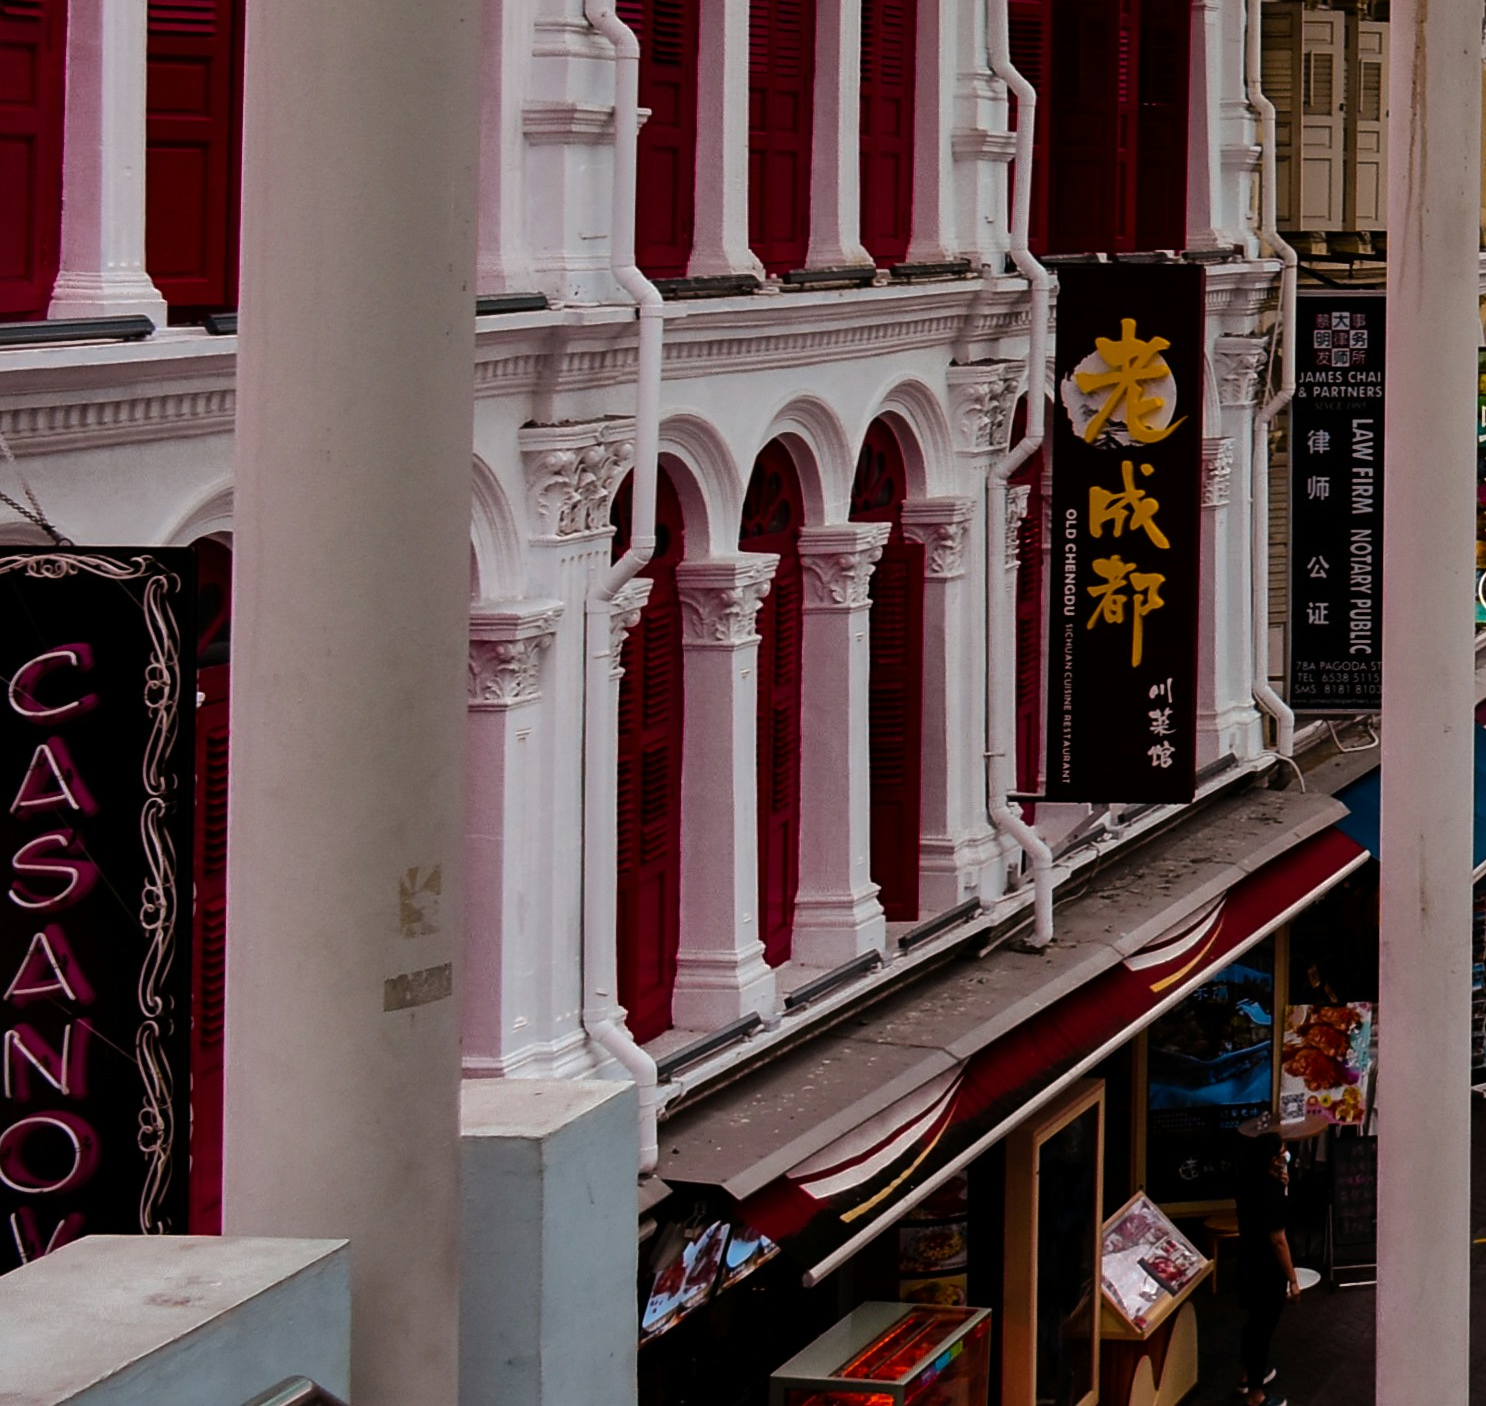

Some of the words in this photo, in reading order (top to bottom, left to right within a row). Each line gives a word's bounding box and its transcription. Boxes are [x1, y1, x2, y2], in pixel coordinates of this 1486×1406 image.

[1298, 387, 1307, 397] &
[1313, 386, 1382, 397] PARTNERS
[1299, 372, 1343, 383] JAMES
[1348, 372, 1381, 383] CHAI
[1352, 418, 1373, 461] LAW
[1075, 318, 1189, 668] 老成都
[1351, 467, 1373, 515] FIRM
[1064, 508, 1077, 539] OLD
[1063, 544, 1077, 617] CHENGDU
[1350, 529, 1372, 594] NOTARY
[1064, 623, 1073, 670] SICHUAN
[1349, 599, 1372, 655] PUBLIC
[1320, 661, 1367, 671] PAGODA
[1321, 673, 1349, 682] 6538
[1353, 673, 1380, 682] 5115
[1063, 672, 1073, 711] CUISINE
[1062, 713, 1072, 784] RESTAURANT
